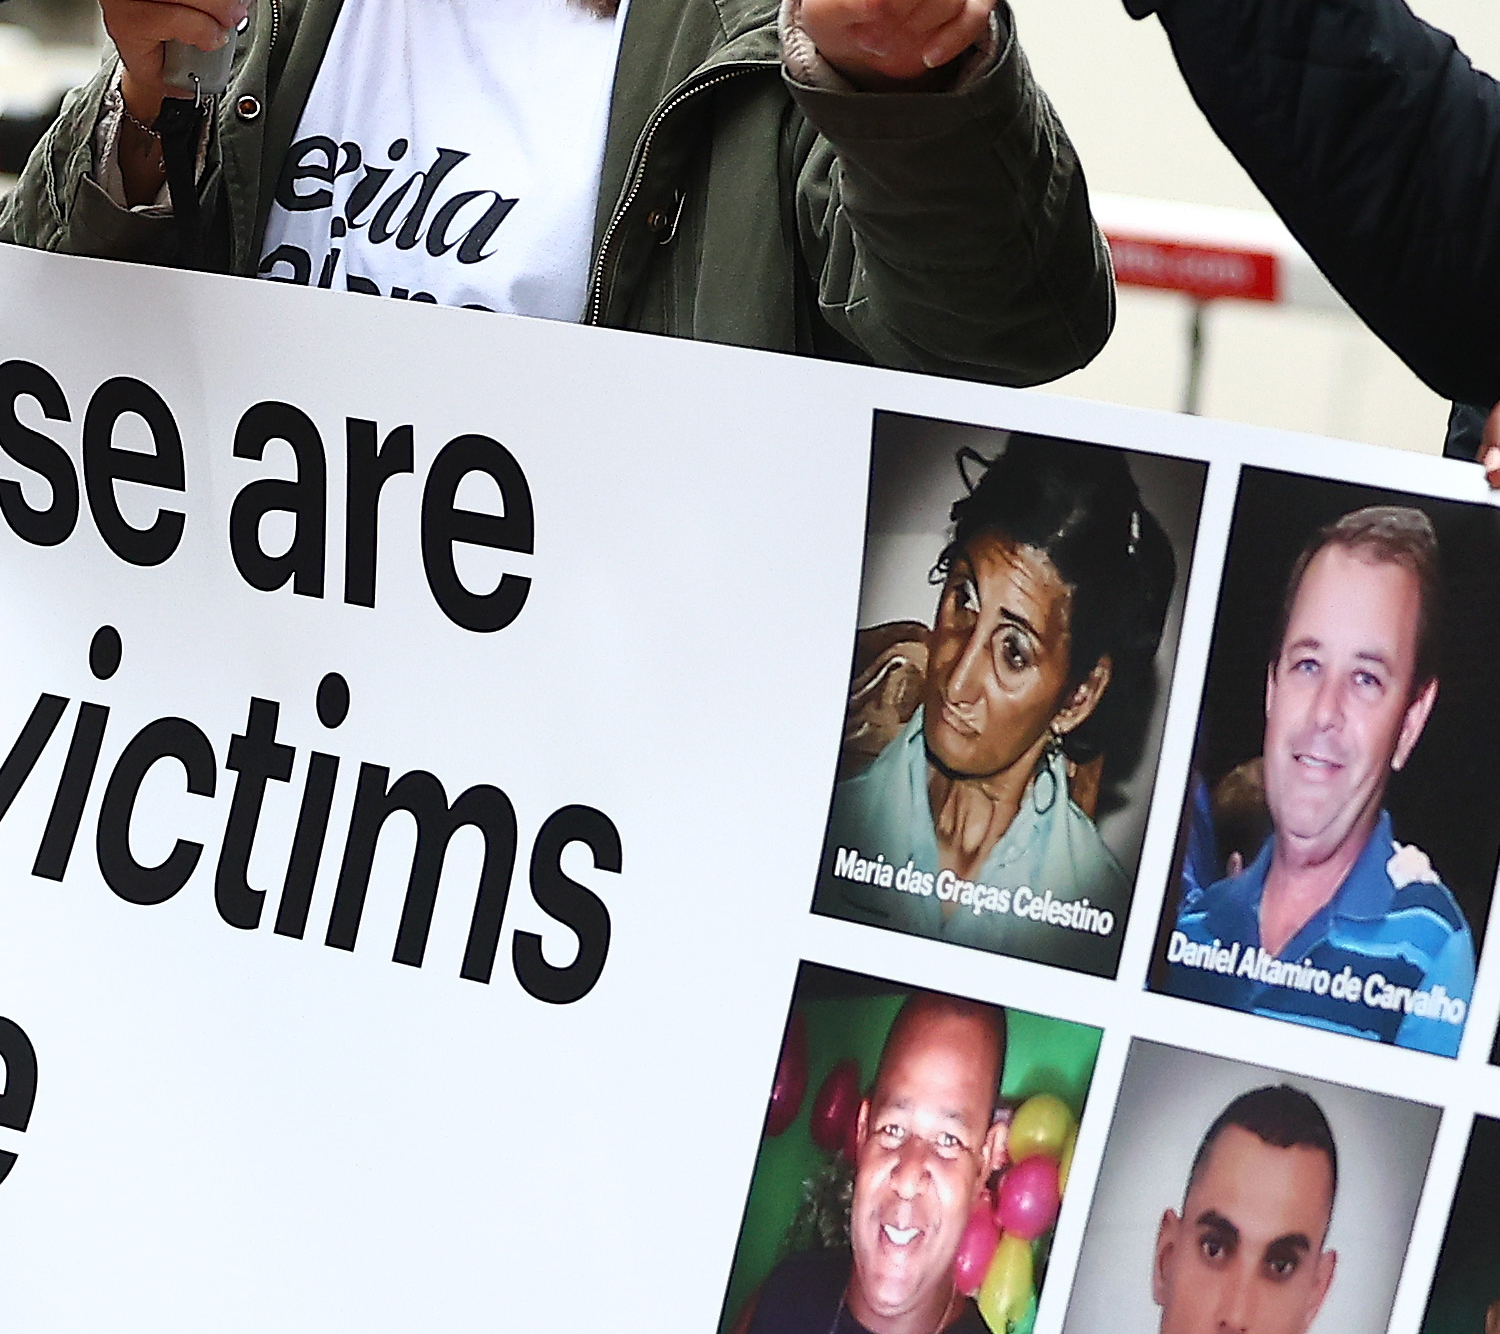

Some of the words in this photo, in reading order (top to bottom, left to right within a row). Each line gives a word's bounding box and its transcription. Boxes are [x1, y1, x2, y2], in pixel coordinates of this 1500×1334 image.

[229, 401, 535, 633] are
[834, 848, 893, 887] Maria
[895, 861, 933, 896] das
[937, 870, 1010, 915] Graças
[1013, 886, 1114, 935] Celestino
[1167, 930, 1240, 974] Daniel
[1240, 947, 1330, 993] Altamiro
[1331, 966, 1362, 999] de
[1363, 973, 1467, 1024] Carvalho
